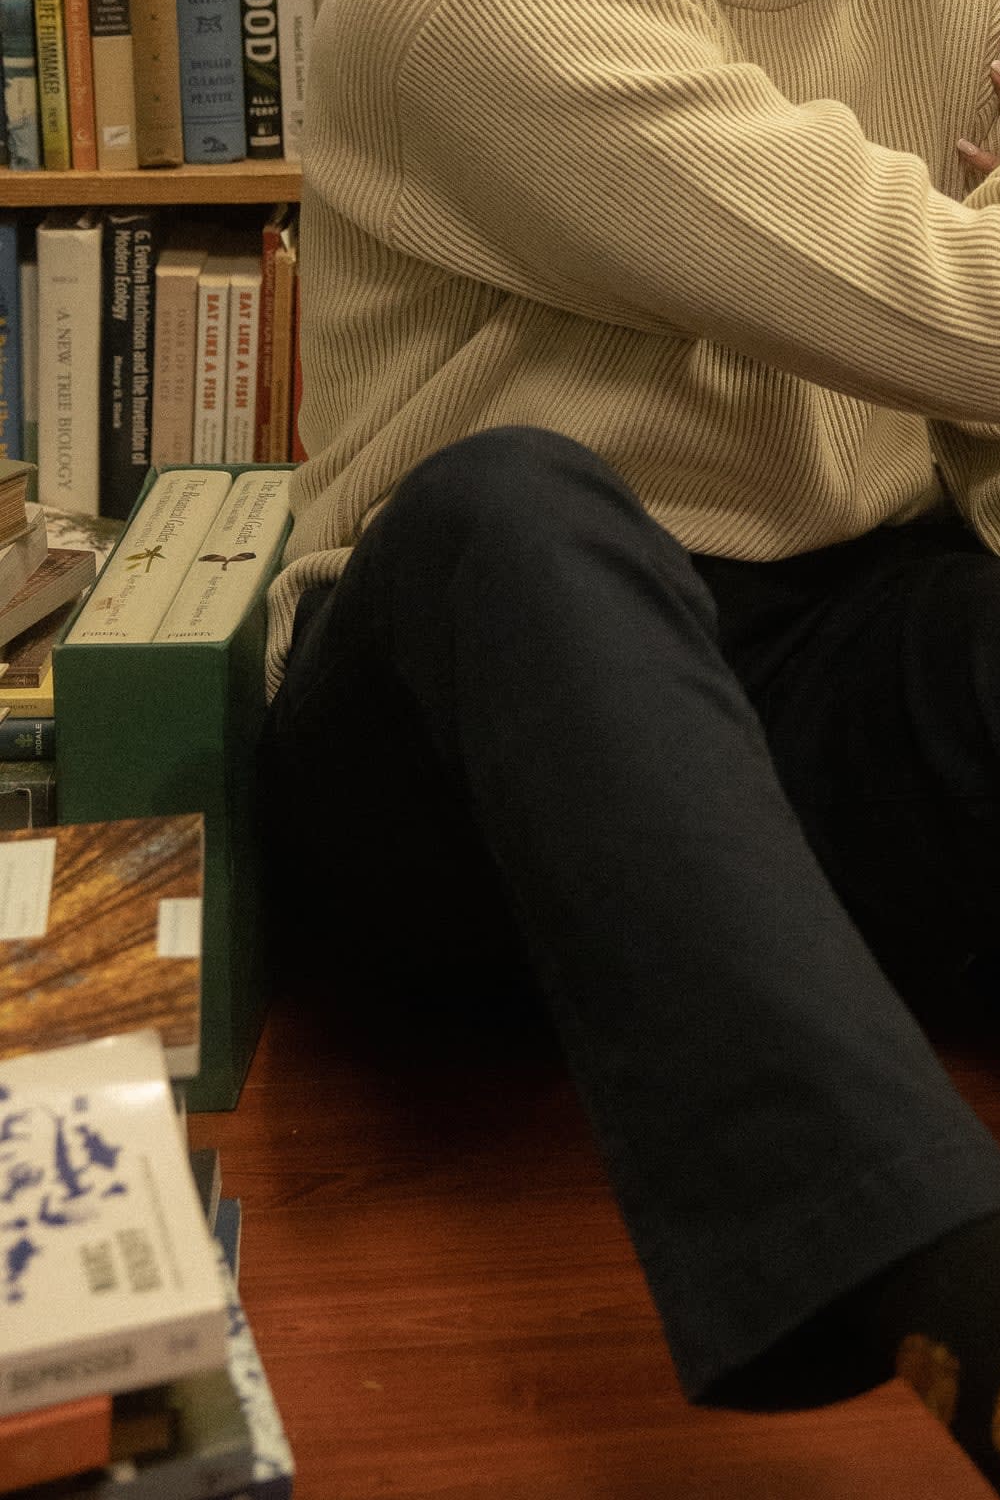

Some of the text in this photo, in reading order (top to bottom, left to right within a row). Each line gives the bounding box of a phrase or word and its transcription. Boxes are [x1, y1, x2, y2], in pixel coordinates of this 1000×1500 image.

[40, 25, 61, 95] FILMMAKER
[57, 309, 72, 491] A NEW TREE BIOLOGY
[132, 230, 150, 465] G. Evelyn Hutchinson and the Invention of
[204, 294, 219, 410] EAT LIKE A FISH
[235, 292, 252, 409] EAT LIKE A FISH
